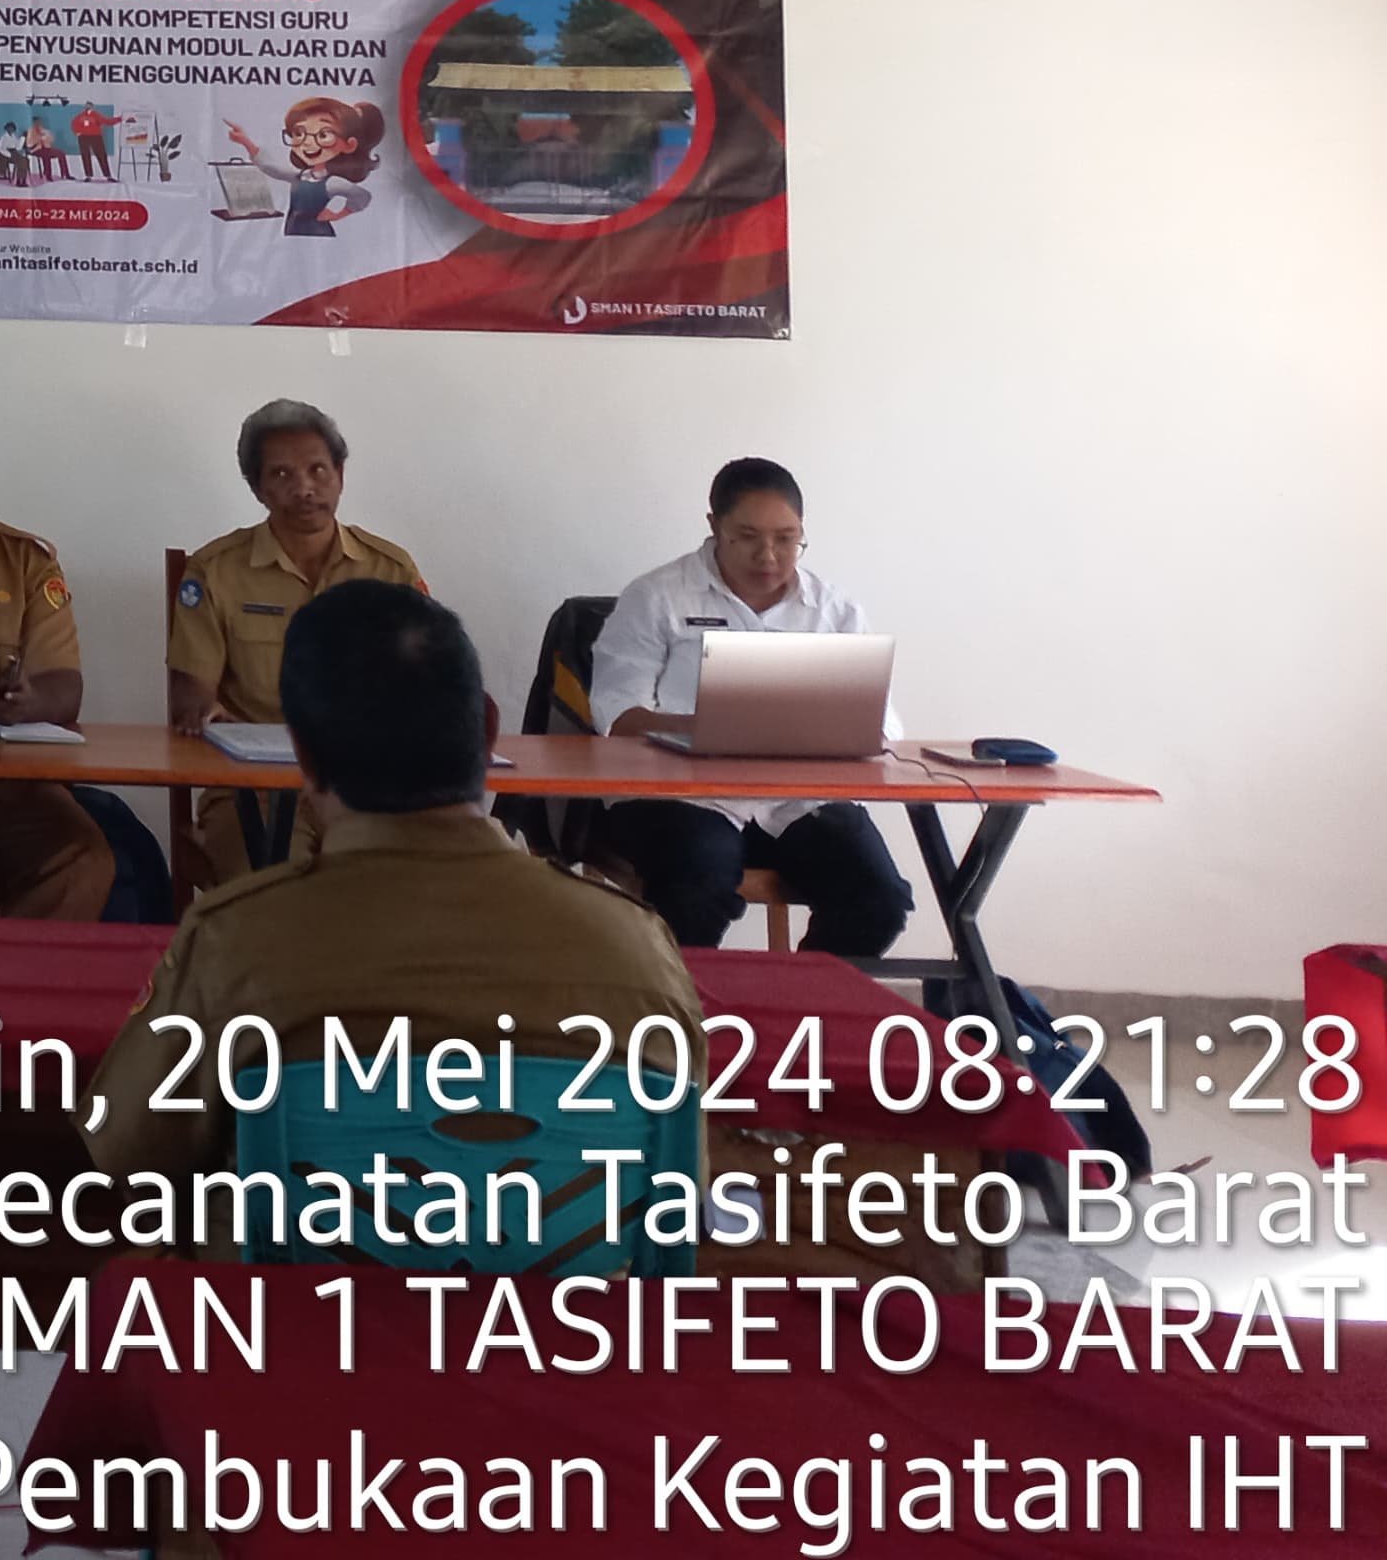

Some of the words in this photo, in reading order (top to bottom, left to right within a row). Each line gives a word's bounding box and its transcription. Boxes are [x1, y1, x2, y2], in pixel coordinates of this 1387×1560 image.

[118, 8, 276, 30] KOMPETENSI
[280, 10, 350, 31] GURU
[167, 37, 255, 58] MODUL
[258, 38, 328, 59] AJAR
[332, 39, 387, 59] DAN
[87, 64, 281, 86] MENGGUNAKAN
[285, 66, 376, 87] CANVA
[25, 209, 66, 220] 20-22
[69, 210, 94, 221] MEI
[96, 210, 130, 222] 2024
[590, 301, 633, 315] SMAN
[635, 302, 641, 315] 1
[645, 303, 716, 317] TASIFETO
[718, 304, 767, 319] BARAT
